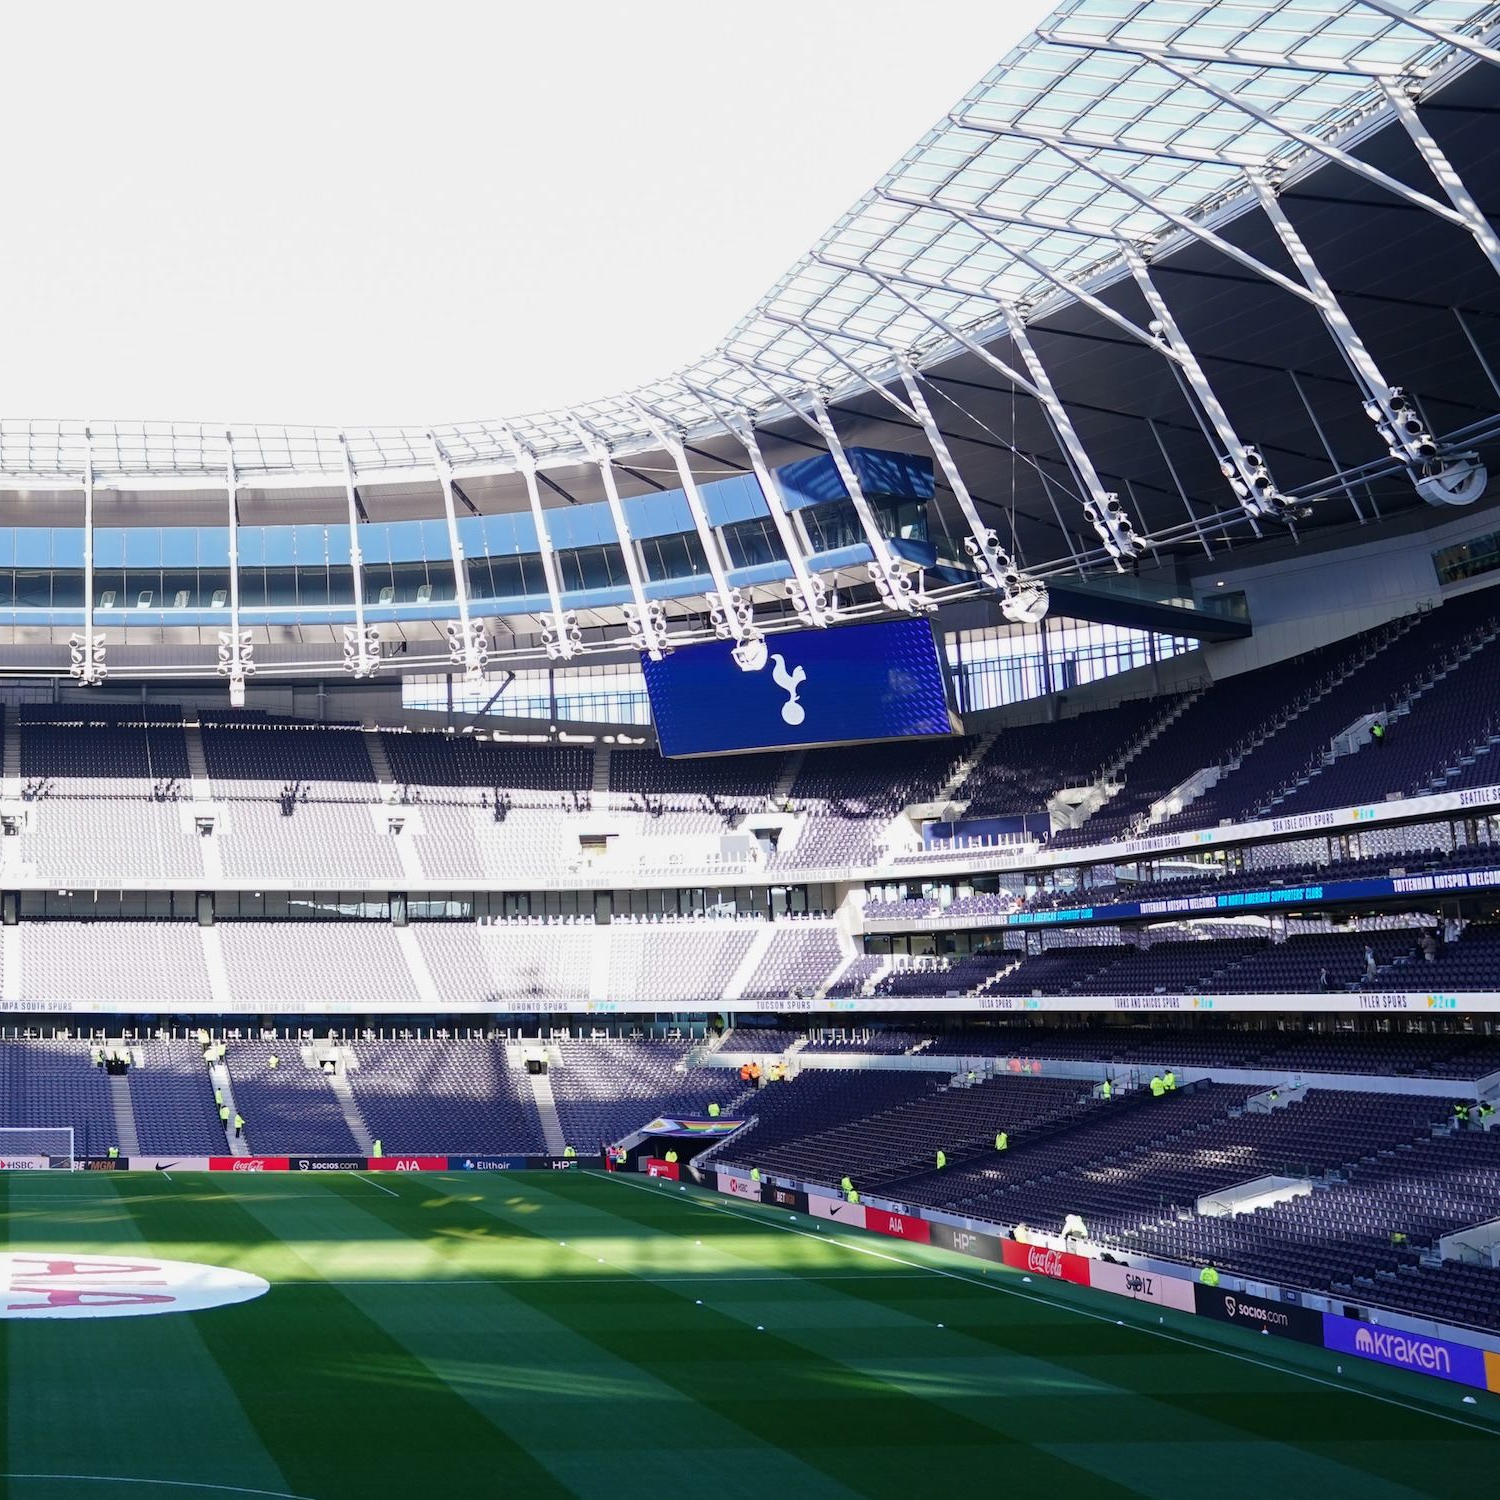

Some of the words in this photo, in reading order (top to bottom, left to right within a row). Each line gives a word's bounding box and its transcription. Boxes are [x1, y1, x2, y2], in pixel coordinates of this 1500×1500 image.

[1460, 790, 1490, 805] SEATTLE
[1285, 819, 1297, 830] ISLE
[1299, 816, 1312, 828] CITY
[1314, 813, 1334, 825] SPURS
[1164, 834, 1181, 848] SPURS
[1393, 876, 1433, 892] TOTTENHAM
[1434, 873, 1467, 889] HOTSPUR
[21, 1002, 45, 1010] SOUTH
[48, 1002, 72, 1011] SPURS
[508, 1002, 540, 1011] TORONTO
[543, 1002, 568, 1011] SPURS
[757, 1001, 784, 1010] TUCSON
[787, 1001, 811, 1010] SPURS
[995, 999, 1012, 1009] SPURS
[1162, 998, 1180, 1008] SPURS
[1359, 996, 1380, 1008] TYLER
[1382, 996, 1407, 1008] SPURS
[74, 1161, 115, 1170] BEMGM
[312, 1160, 358, 1169] socios.com
[396, 1160, 420, 1171] AIA
[476, 1159, 510, 1169] Elithair
[889, 1216, 903, 1235] AIA
[7, 1259, 177, 1311] AIA
[1238, 1302, 1288, 1327] socios.com
[1374, 1332, 1451, 1374] kraken
